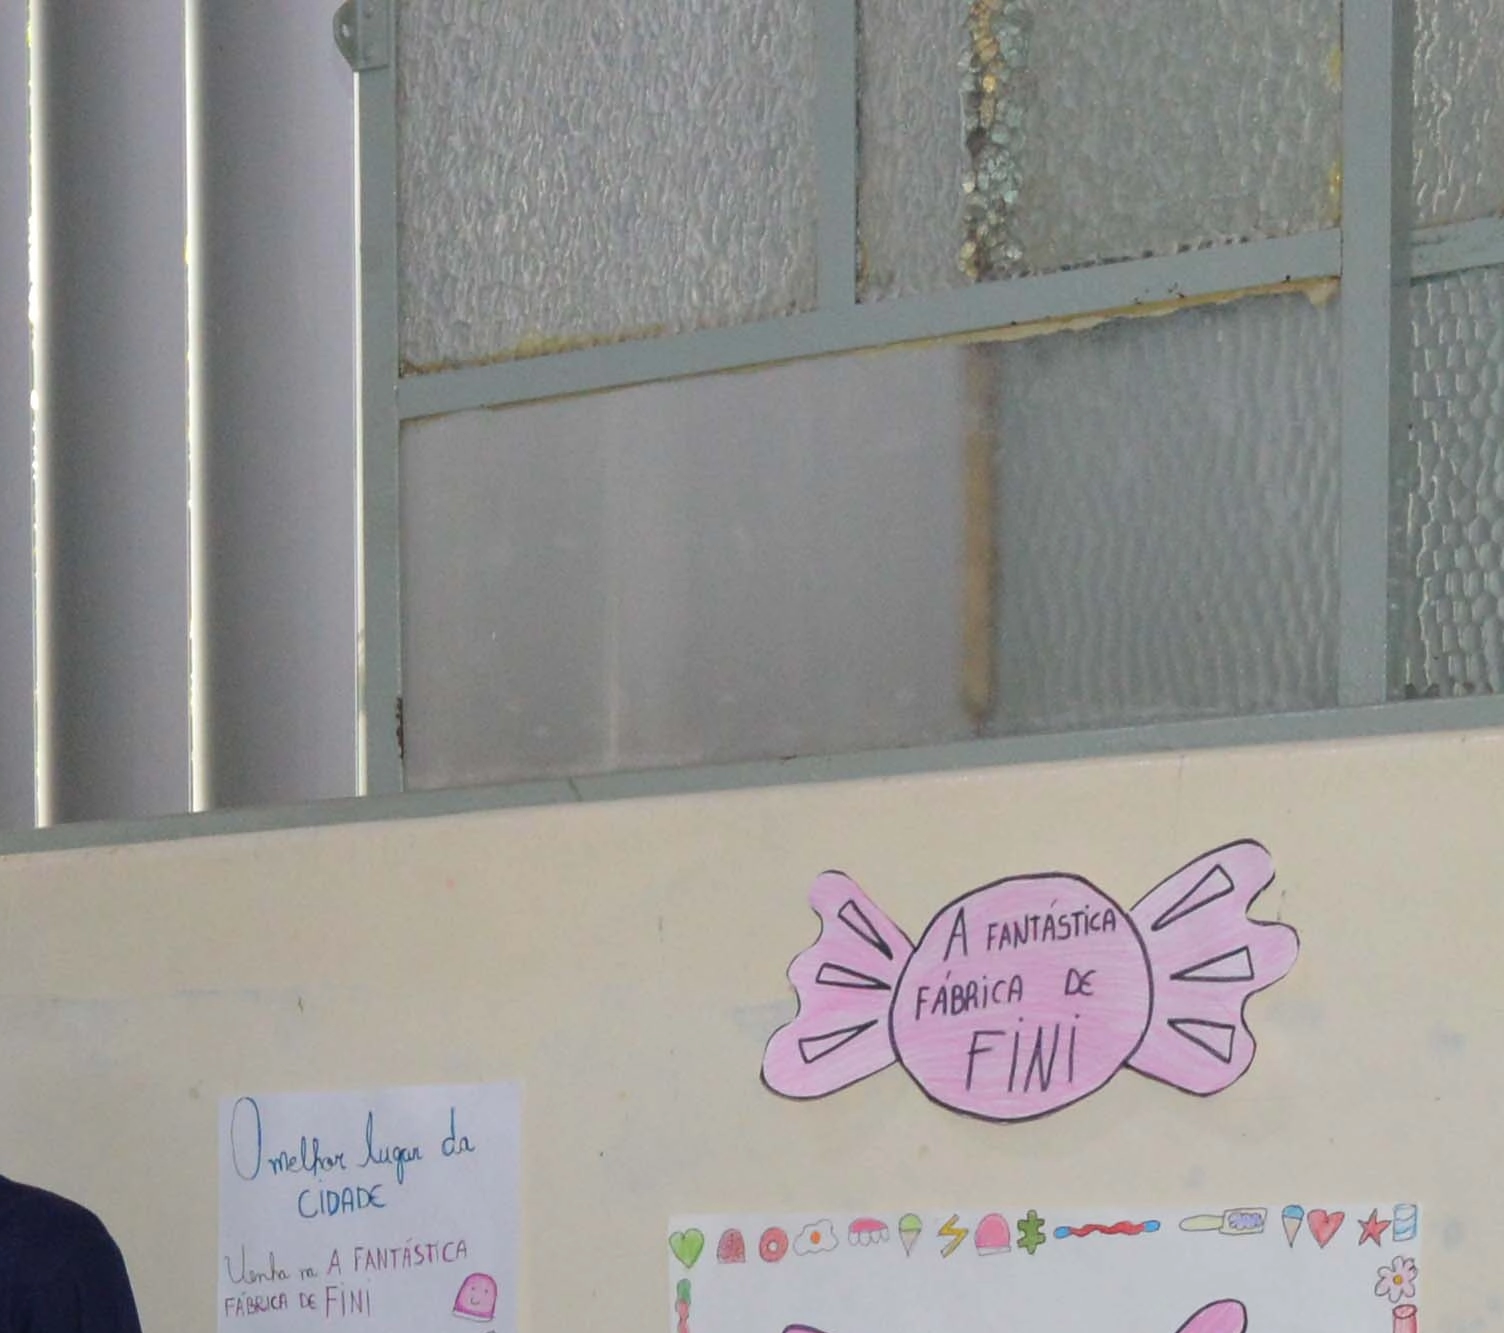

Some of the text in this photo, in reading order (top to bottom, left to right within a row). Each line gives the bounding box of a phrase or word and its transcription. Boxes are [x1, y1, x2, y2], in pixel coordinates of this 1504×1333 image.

[943, 905, 969, 962] A
[1064, 967, 1097, 997] DE
[230, 1095, 477, 1185] O melhor lugar da
[297, 1181, 387, 1219] CIDADE
[224, 1242, 290, 1285] Venha
[325, 1248, 342, 1277] A
[299, 1291, 317, 1310] DE
